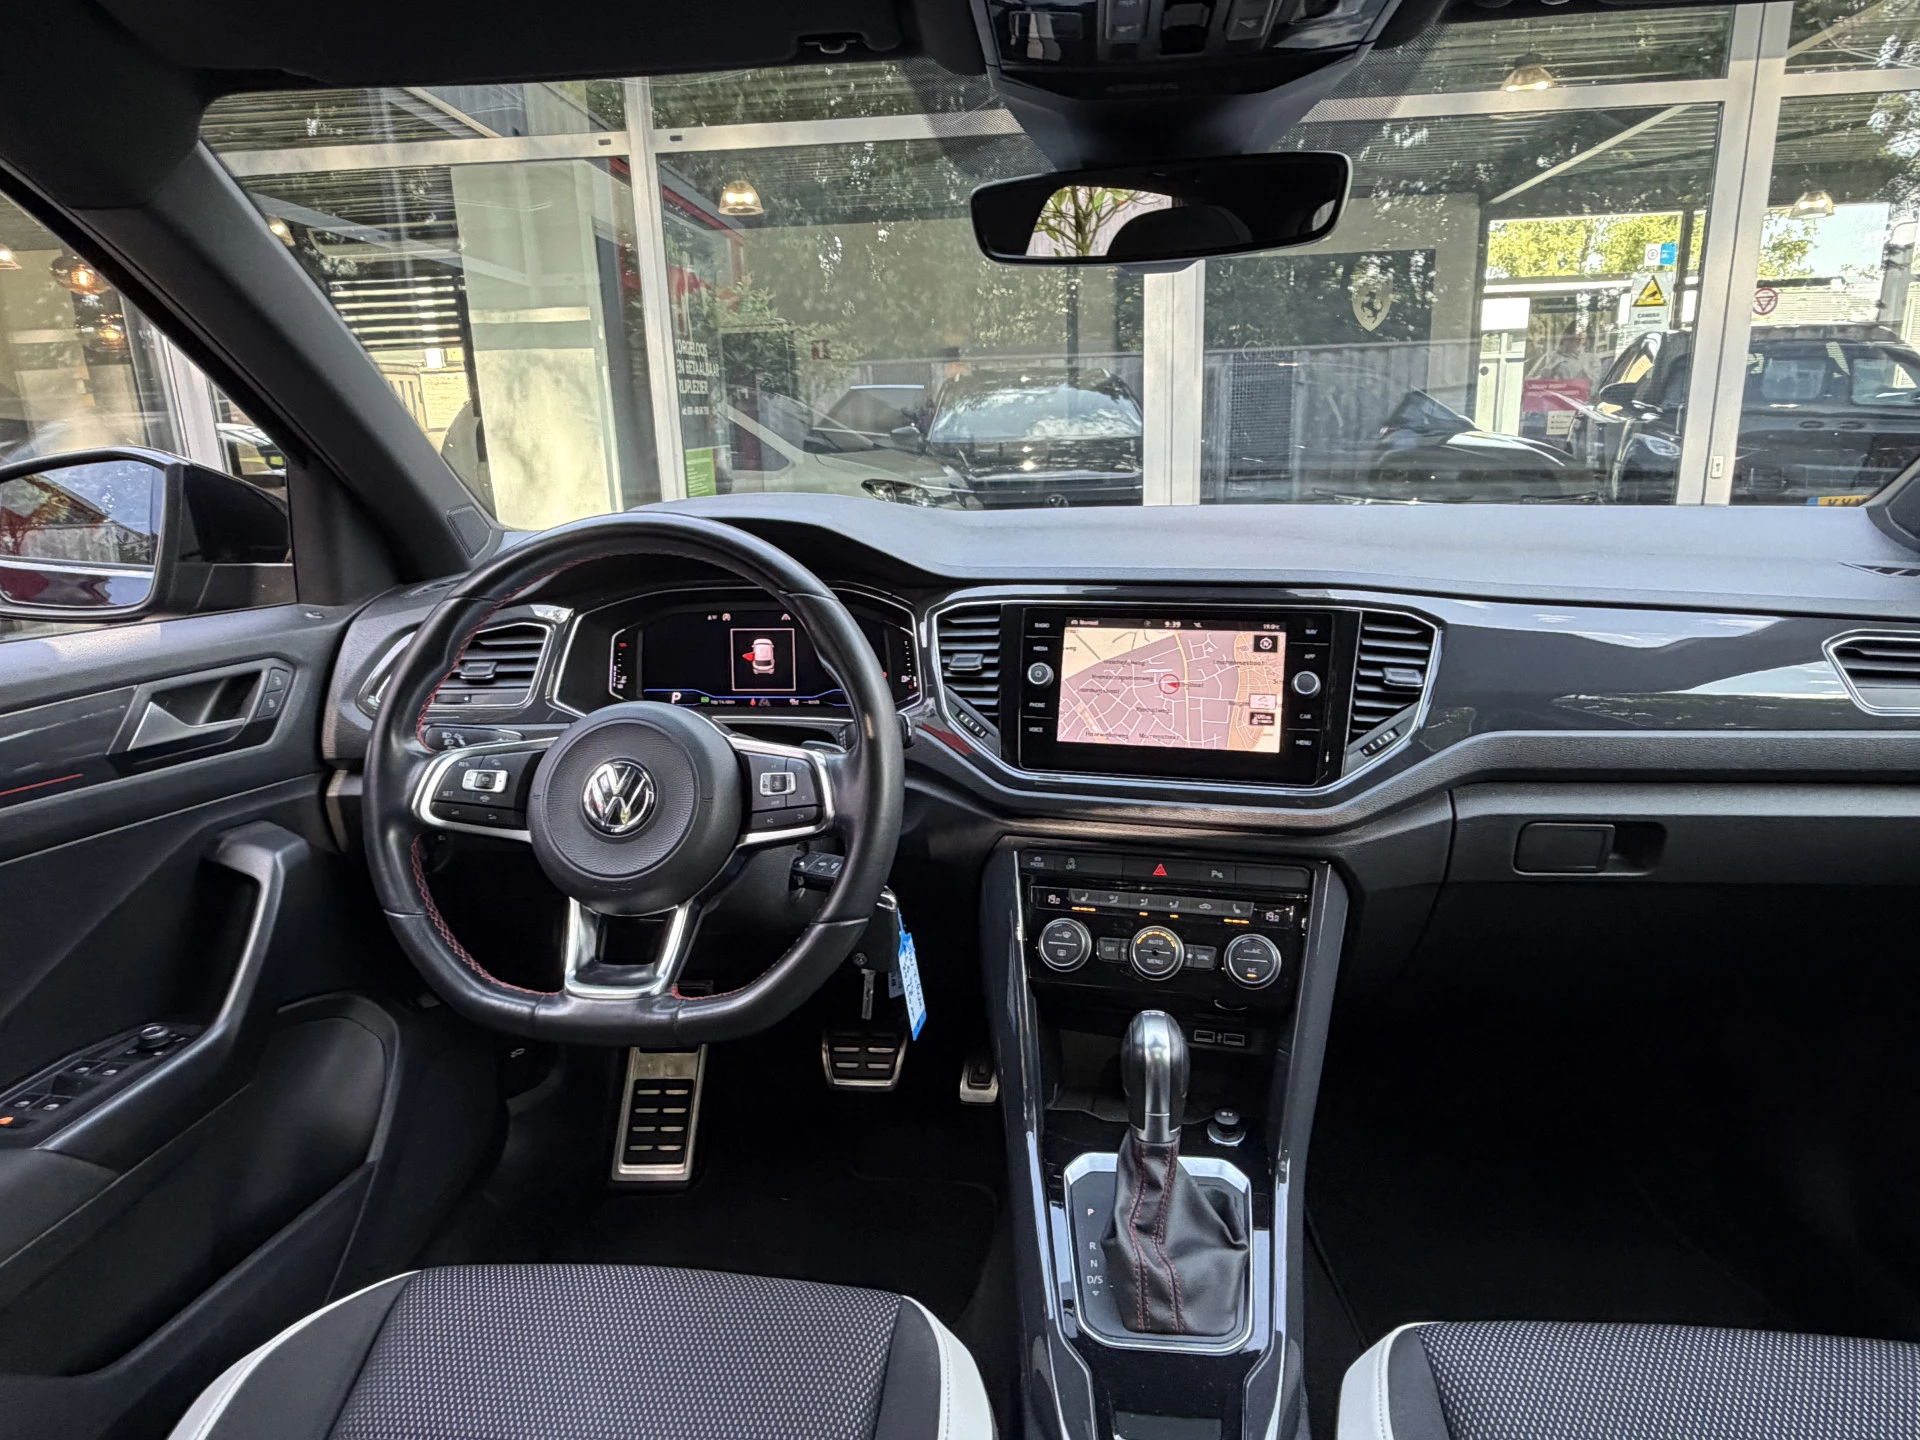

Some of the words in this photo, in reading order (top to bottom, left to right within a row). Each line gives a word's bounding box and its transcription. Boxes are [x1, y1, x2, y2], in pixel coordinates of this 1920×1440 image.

[671, 692, 682, 704] P
[1087, 1208, 1095, 1217] P
[1089, 1241, 1097, 1250] R
[1090, 1259, 1099, 1268] N
[1086, 1275, 1104, 1285] D/S
